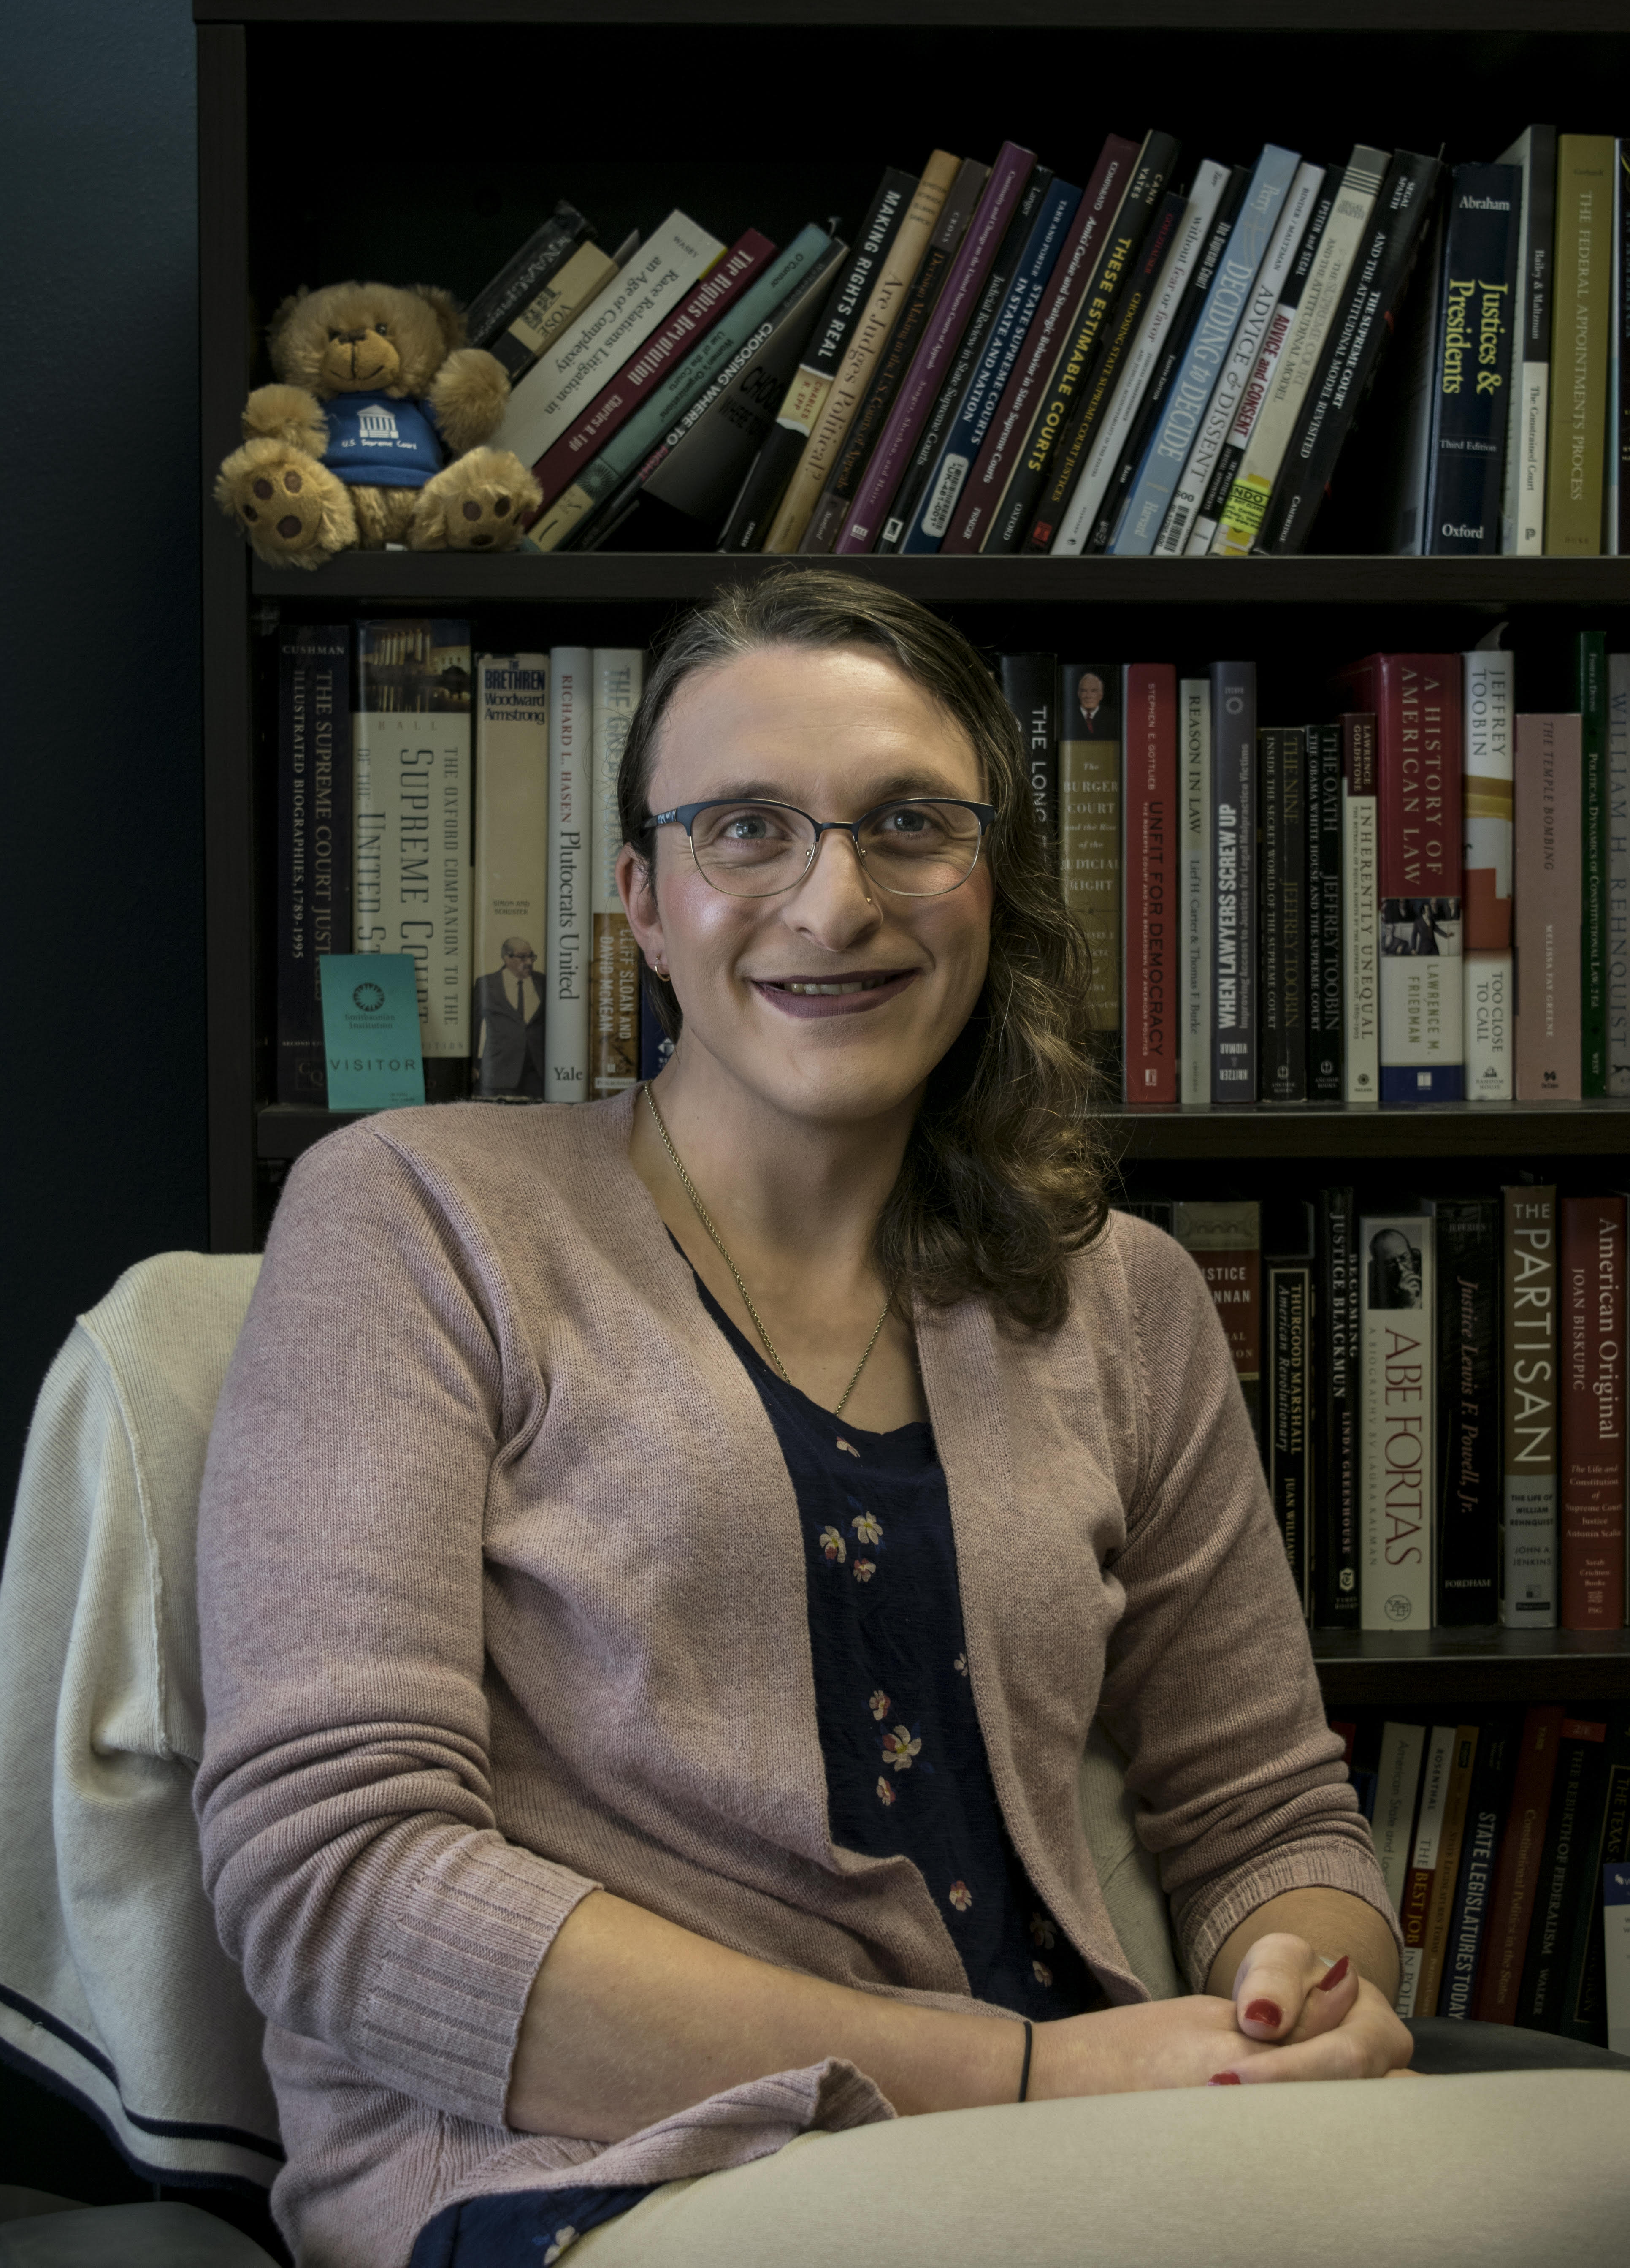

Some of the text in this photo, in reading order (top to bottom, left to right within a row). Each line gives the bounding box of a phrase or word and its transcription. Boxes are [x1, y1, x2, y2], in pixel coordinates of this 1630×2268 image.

[1458, 195, 1510, 212] Abraham
[1576, 229, 1592, 298] FEDERAL
[1579, 190, 1593, 222] THE
[544, 268, 680, 418] Race Relations Litigation in
[551, 255, 663, 376] an Age of Complexity
[625, 246, 755, 389] The Rights Revolution
[818, 189, 902, 361] MAKING RIGHTS REAL
[1441, 278, 1476, 395] Presidents
[1475, 281, 1508, 396] Justices &
[802, 272, 904, 482] Are Judges Political?
[961, 276, 1029, 423] IN STATE AND NATION
[969, 282, 1045, 446] STATE SUPREME COURTS
[1025, 234, 1133, 472] THESE ESTIMABLE COURTS
[1153, 259, 1256, 463] DECIDING to DECIDE
[1189, 284, 1276, 483] ADVICE & DISSENT
[1232, 313, 1290, 438] ADVICE and CONSENT
[1298, 230, 1388, 460] AND THE ATTITUDINAL MODEL REVISITED
[1330, 288, 1382, 409] THE SUPREME COURT
[1572, 303, 1589, 429] APPOINTMENTS
[1440, 439, 1497, 451] Third Edition
[1569, 434, 1584, 500] PROCESS
[1441, 523, 1485, 541] Oxford
[282, 646, 344, 655] CUSHMAN
[485, 670, 544, 690] BRETHREN
[485, 694, 544, 706] Woodward
[485, 711, 544, 724] Armstrong
[1472, 668, 1486, 756] TOOBIN
[1490, 670, 1505, 756] JEFFREY
[292, 670, 304, 958] ILLUSTRATED BIOGRAPHIES, 1789-1995
[560, 674, 572, 822] RICHARD L. HASEN
[1188, 696, 1200, 834] REASON IN LAW
[1283, 737, 1299, 824] THE NINE
[1322, 734, 1338, 831] THE OATH
[1401, 667, 1419, 885] AMERICAN LAW
[1423, 676, 1443, 875] A HISTORY OF
[1543, 721, 1553, 871] THE TEMPLE BOMBING
[400, 749, 434, 903] SUPREME
[443, 747, 458, 1025] THE OXFORD COMPANION TO THE
[1608, 692, 1626, 1048] WILLIAM H. REHNQUIST
[559, 831, 580, 999] Plutocrats United
[1149, 801, 1162, 1056] UNFIT FOR DEMOCRACY
[1218, 804, 1237, 1029] WHEN LAWYERS SCREW UP
[1279, 879, 1298, 1027] JEFFREY TOOBIN
[1319, 871, 1340, 1030] JEFFREY TOOBIN
[1359, 805, 1372, 1039] INHERENTLY UNEQUAL
[330, 1059, 416, 1071] VISITOR
[554, 1067, 584, 1081] Yale
[1408, 976, 1419, 1043] FRIEDMAN
[1476, 982, 1487, 1043] TO CALL
[1491, 971, 1503, 1052] TOO CLOSE
[1514, 1203, 1551, 1218] THE
[1291, 1284, 1302, 1455] THURGOOD MARSHALL
[1329, 1211, 1345, 1397] JUSTICE BLACKMUN
[1514, 1227, 1551, 1462] PARTISAN
[1571, 1268, 1585, 1391] JOAN BISKUPIC
[1593, 1217, 1619, 1441] American Original
[1384, 1327, 1422, 1565] ABE FORTAS
[1456, 1275, 1479, 1513] Justice Lewis F. Powell, Jr.
[1341, 1411, 1350, 1553] LINDA GREENHOUSE
[1444, 1579, 1491, 1589] FORDHAM
[1559, 1780, 1578, 1843] REBIRTH
[1569, 1748, 1584, 1777] THE
[1447, 1811, 1496, 2021] STATE LEGISLATURES TODAY
[1541, 1865, 1566, 1956] FEDERALISM
[1555, 1843, 1569, 1862] OF
